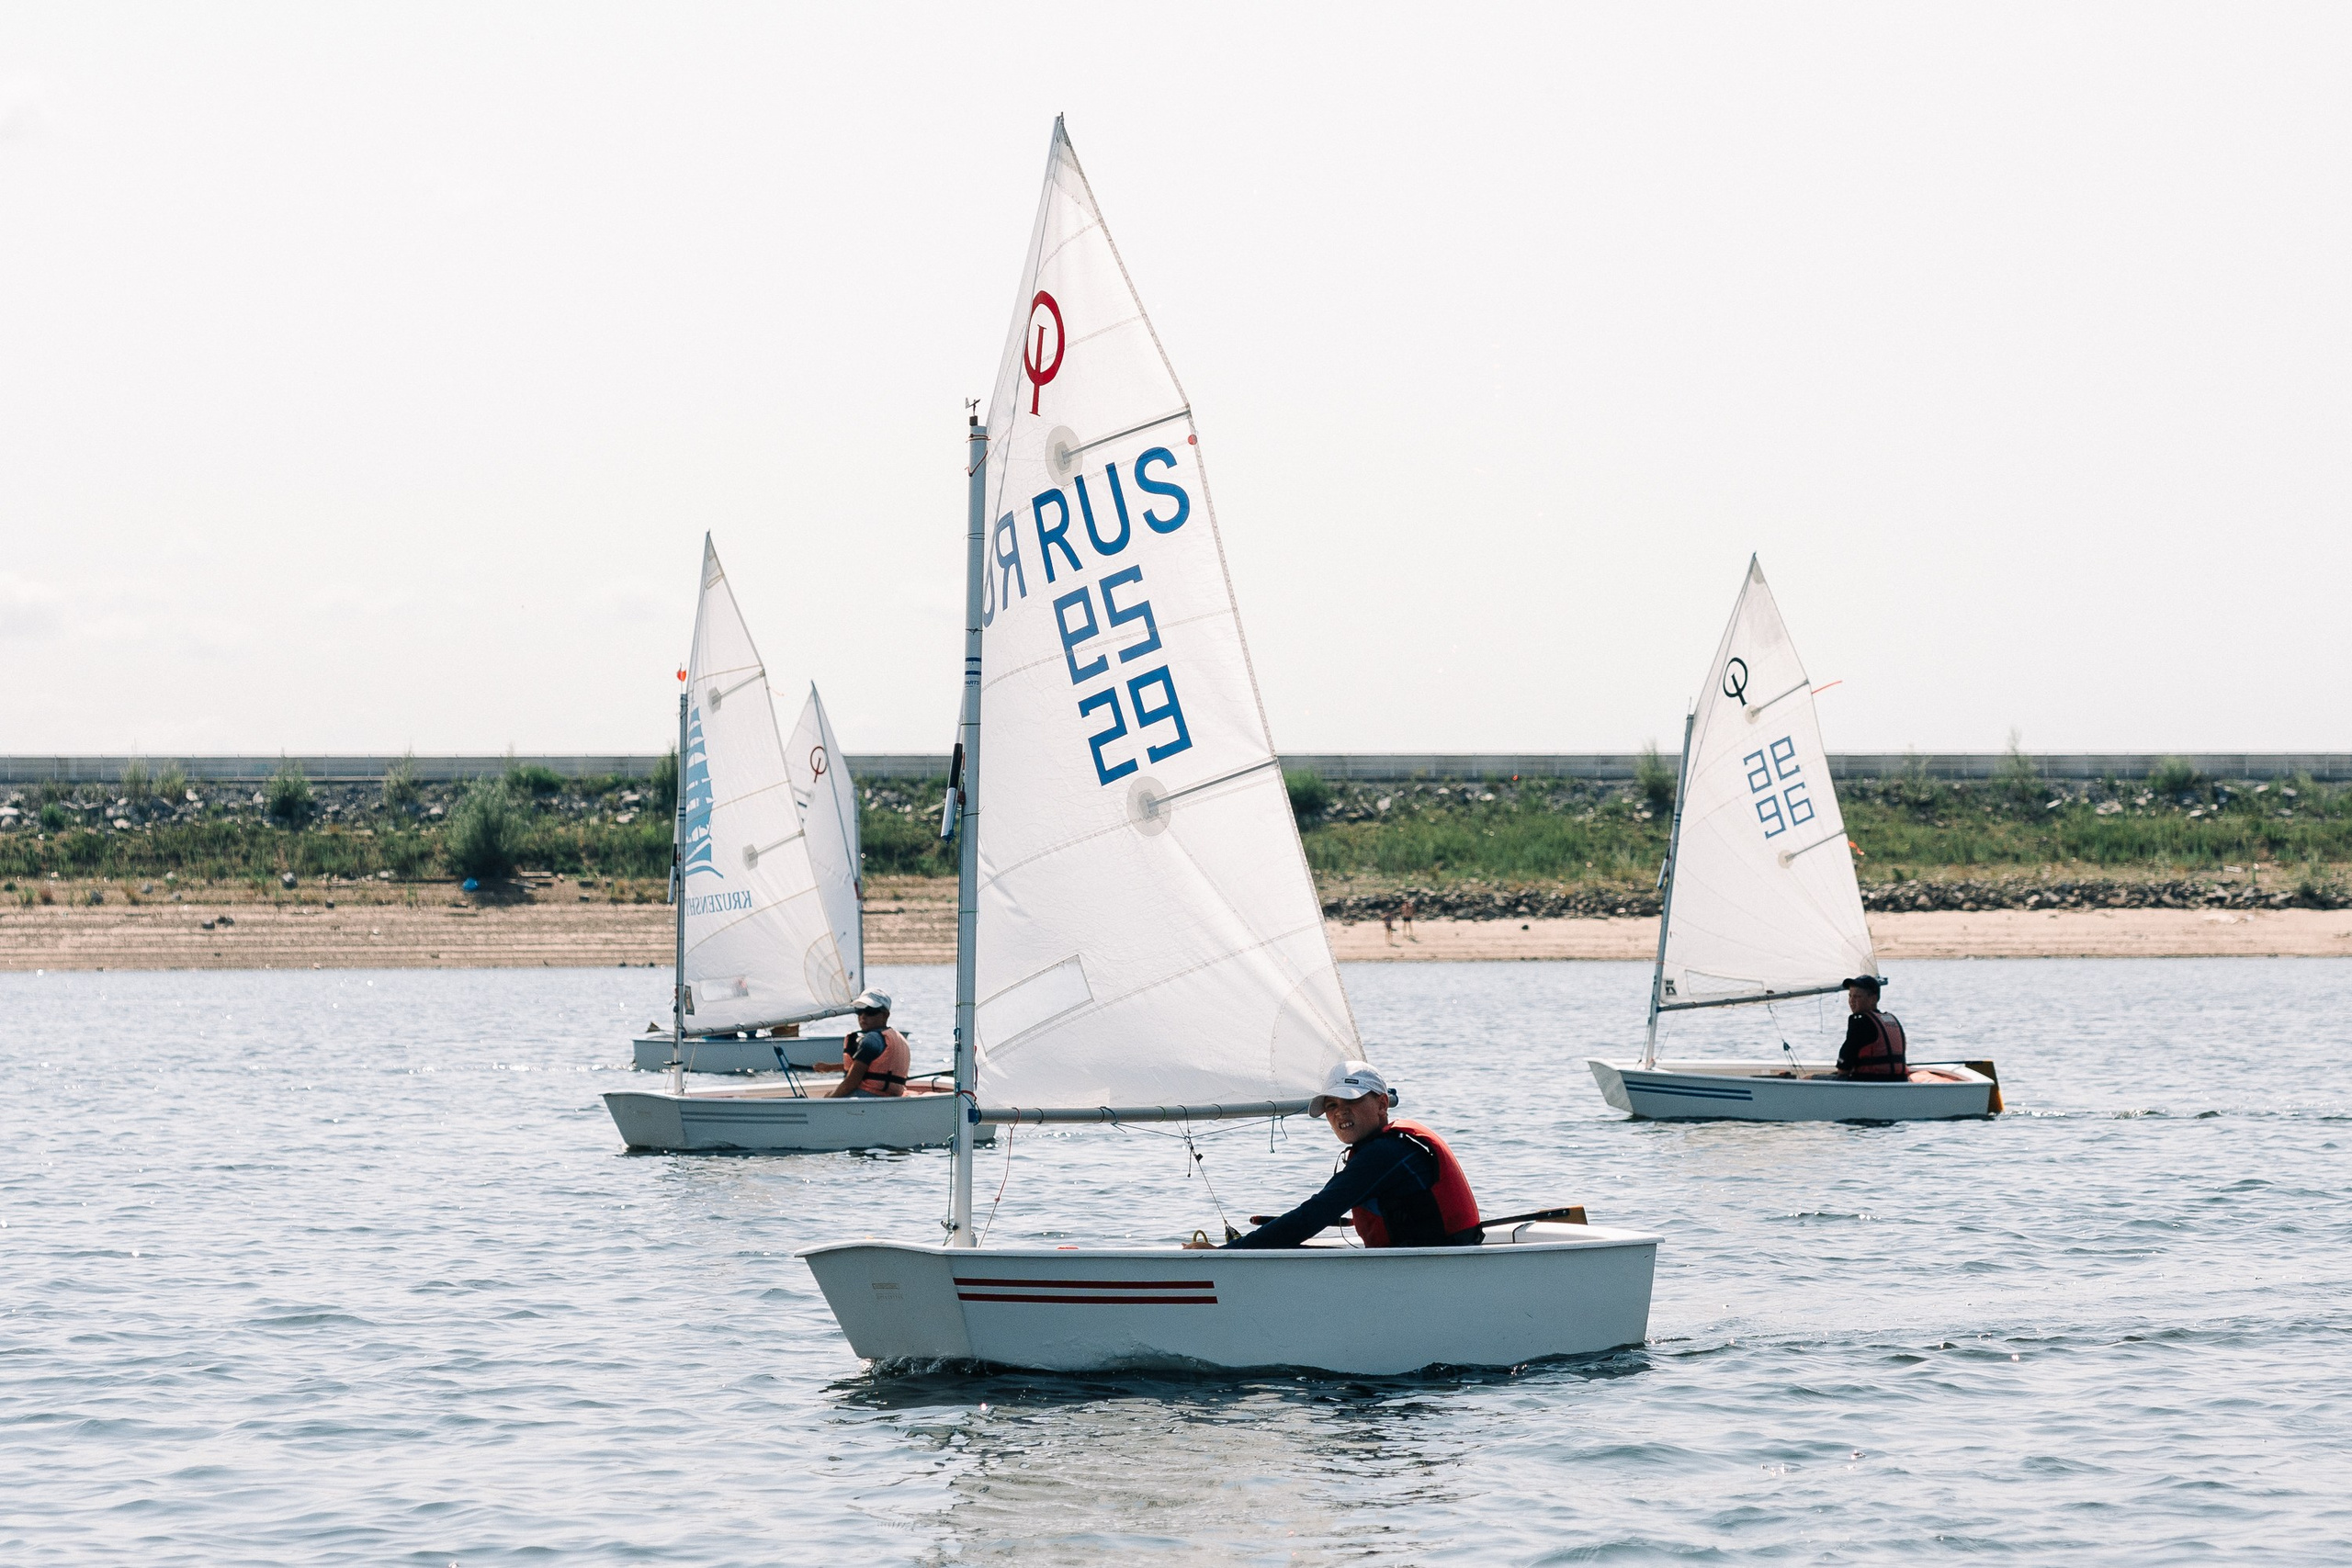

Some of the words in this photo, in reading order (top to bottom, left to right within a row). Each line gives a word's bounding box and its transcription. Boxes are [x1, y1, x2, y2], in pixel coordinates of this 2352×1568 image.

[1032, 446, 1190, 583] RUS
[1078, 665, 1193, 785] 29
[1756, 782, 1815, 840] 96
